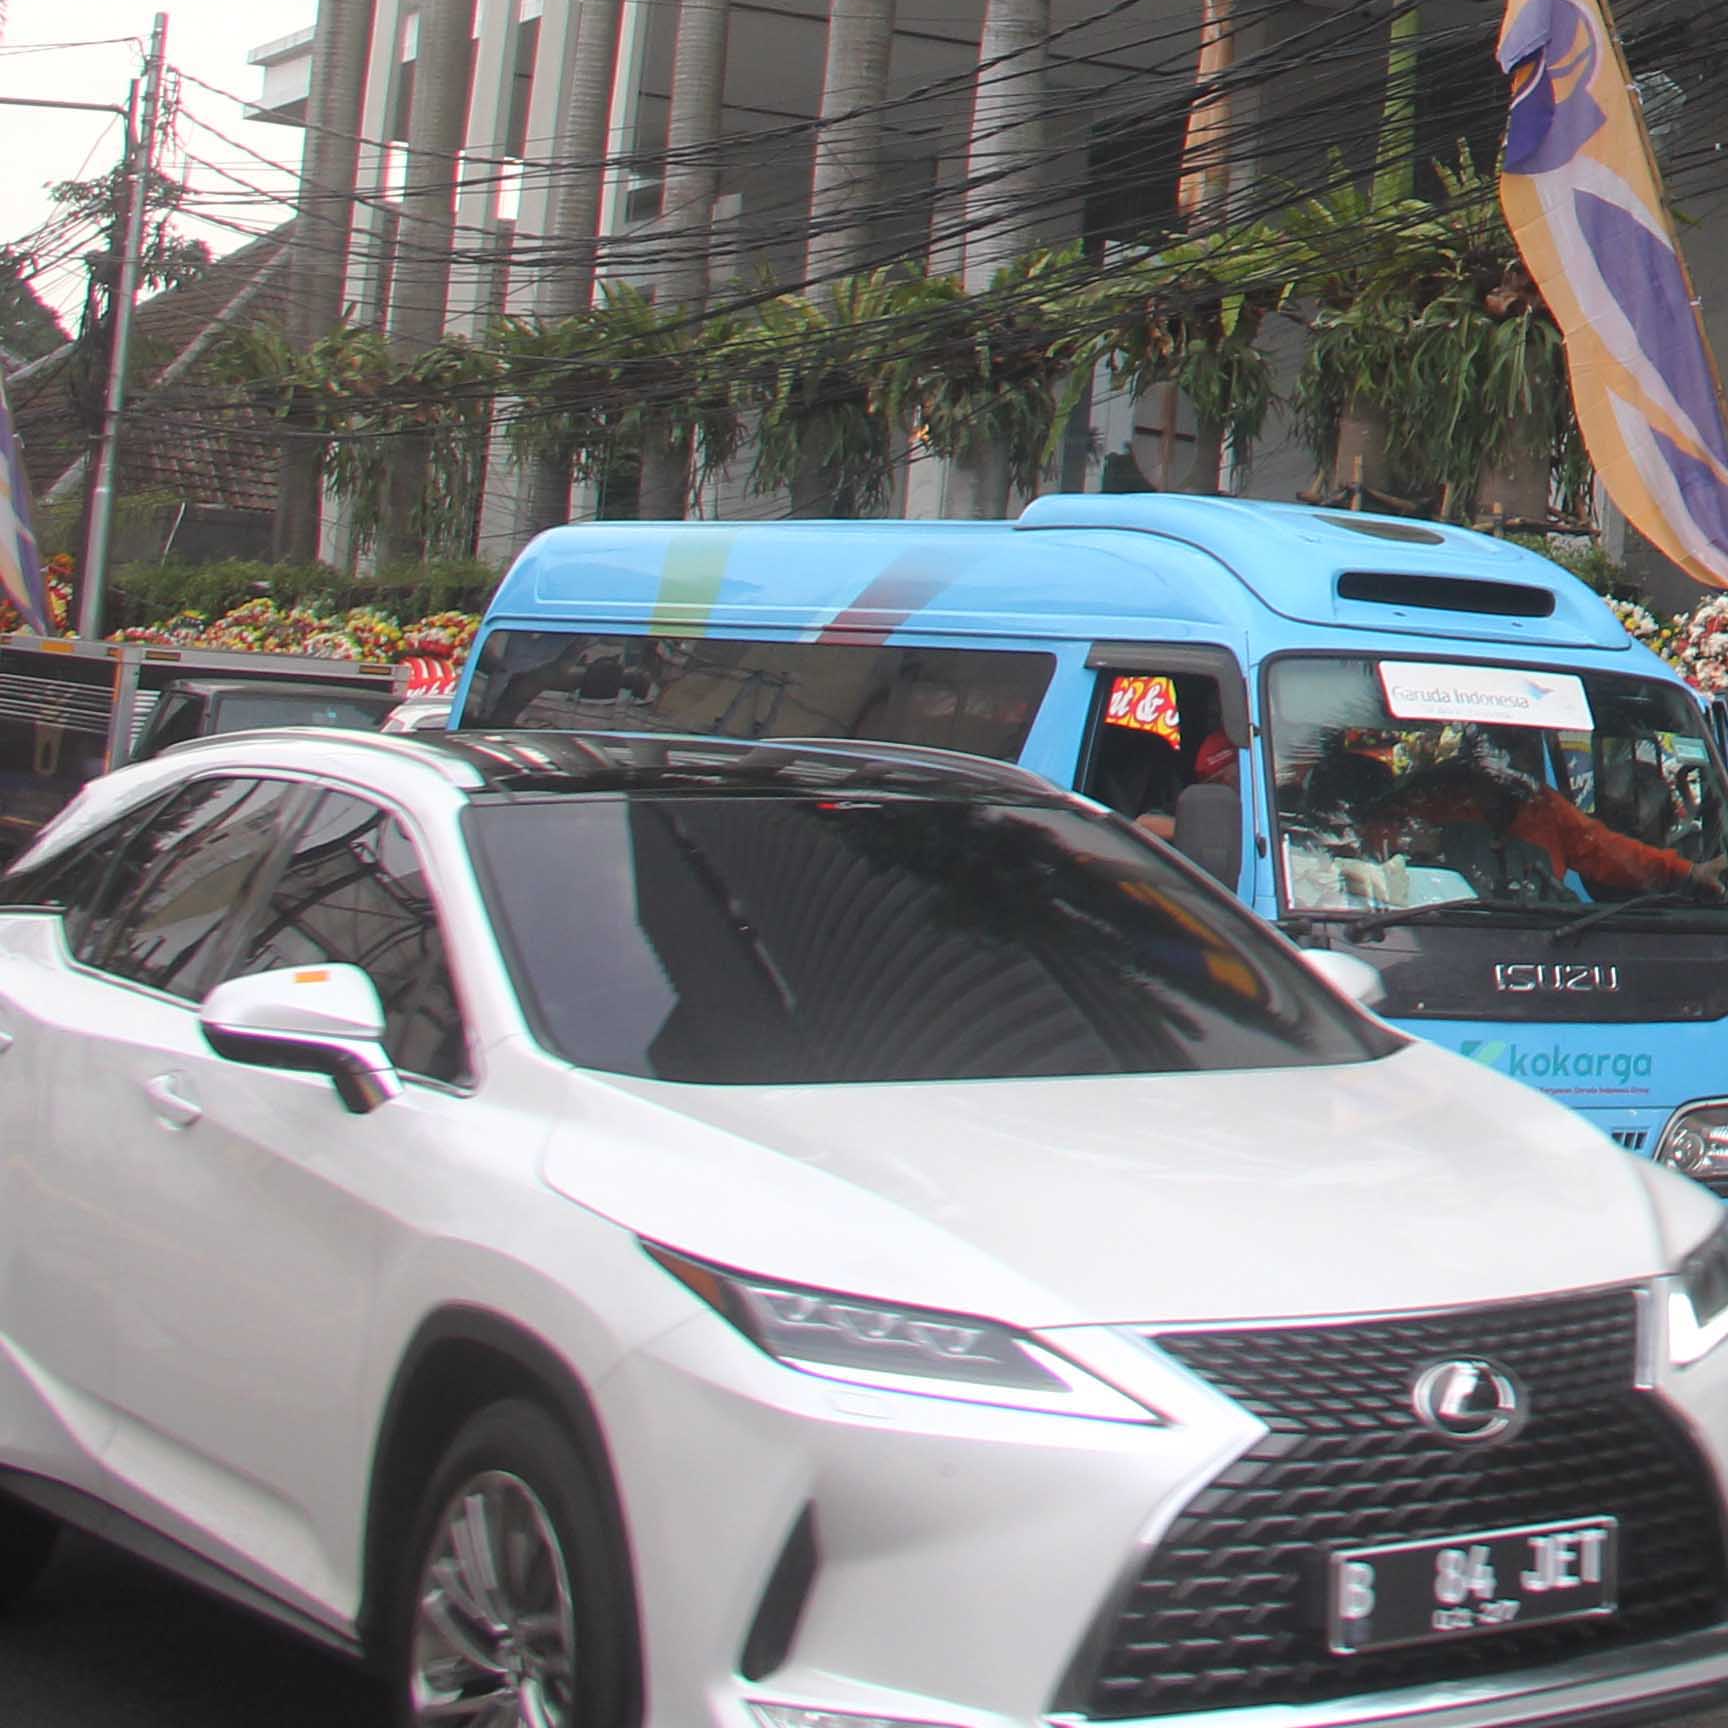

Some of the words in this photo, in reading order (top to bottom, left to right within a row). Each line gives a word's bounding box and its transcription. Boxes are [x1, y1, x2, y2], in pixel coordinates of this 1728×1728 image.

[1392, 686, 1451, 703] Garuda
[1454, 688, 1529, 709] Indonesia
[1495, 964, 1619, 991] ISUZU
[1509, 1041, 1653, 1085] kokarga
[1338, 1560, 1376, 1619] B
